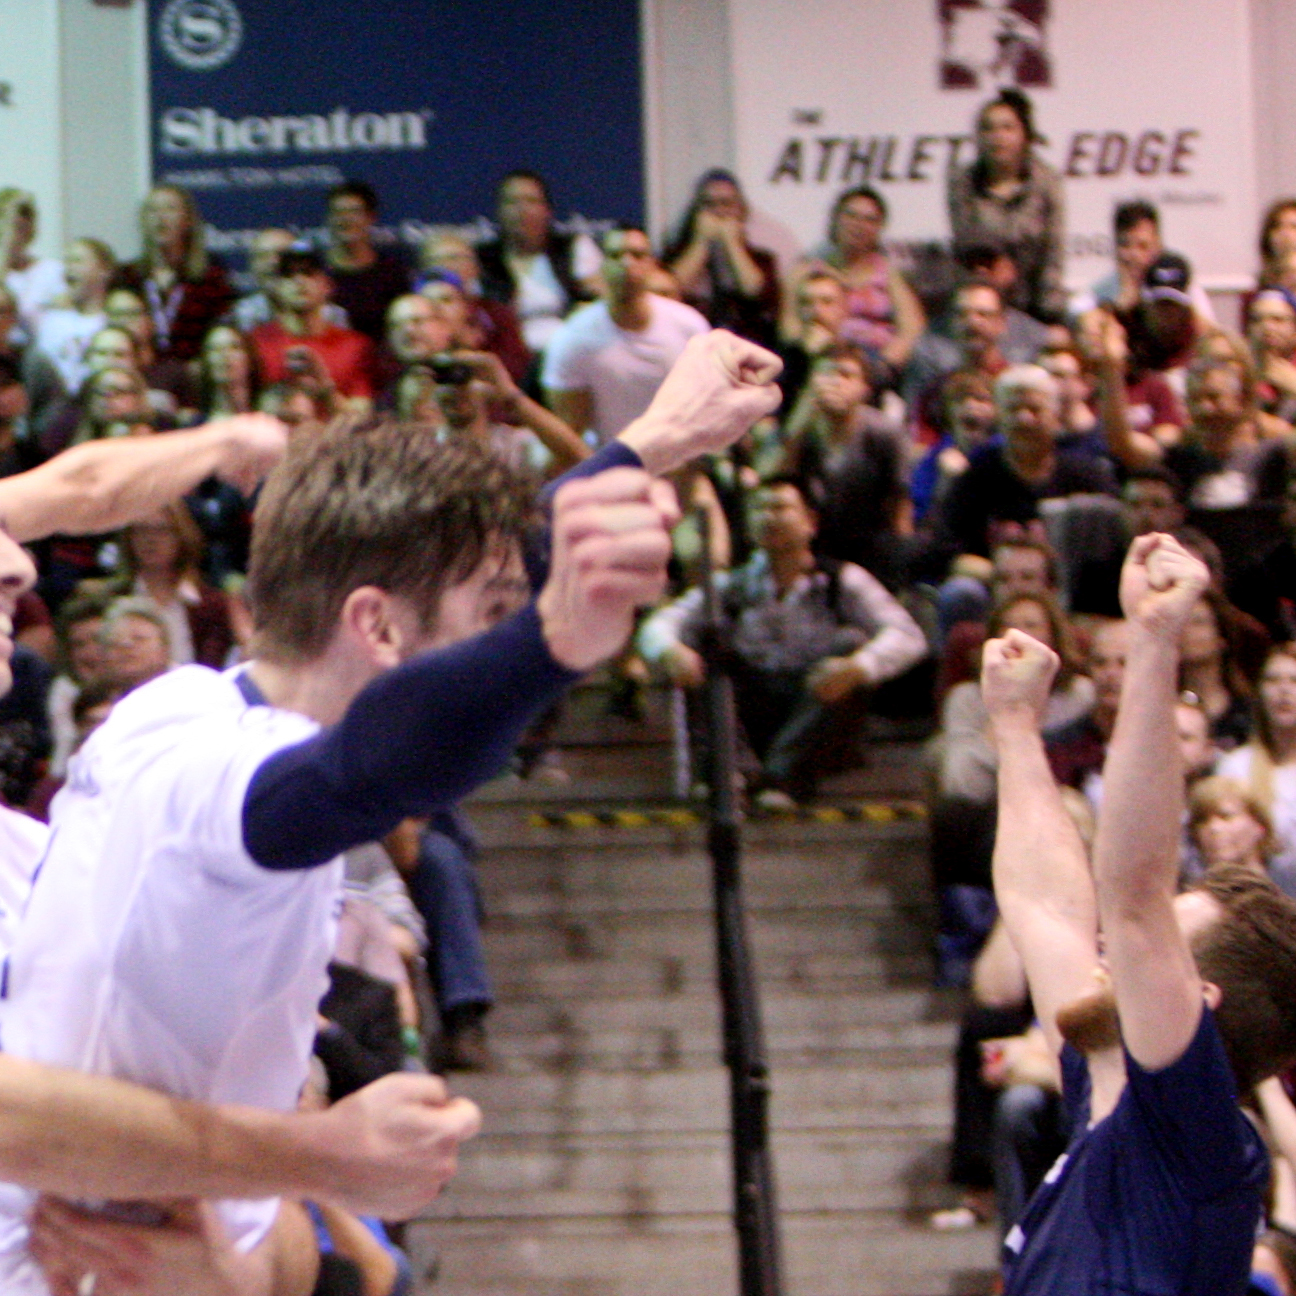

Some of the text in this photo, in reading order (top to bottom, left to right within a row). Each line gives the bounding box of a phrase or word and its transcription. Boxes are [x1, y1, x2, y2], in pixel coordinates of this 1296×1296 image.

[161, 107, 427, 153] Sheraton
[769, 128, 1201, 184] ATHLET EDGE
